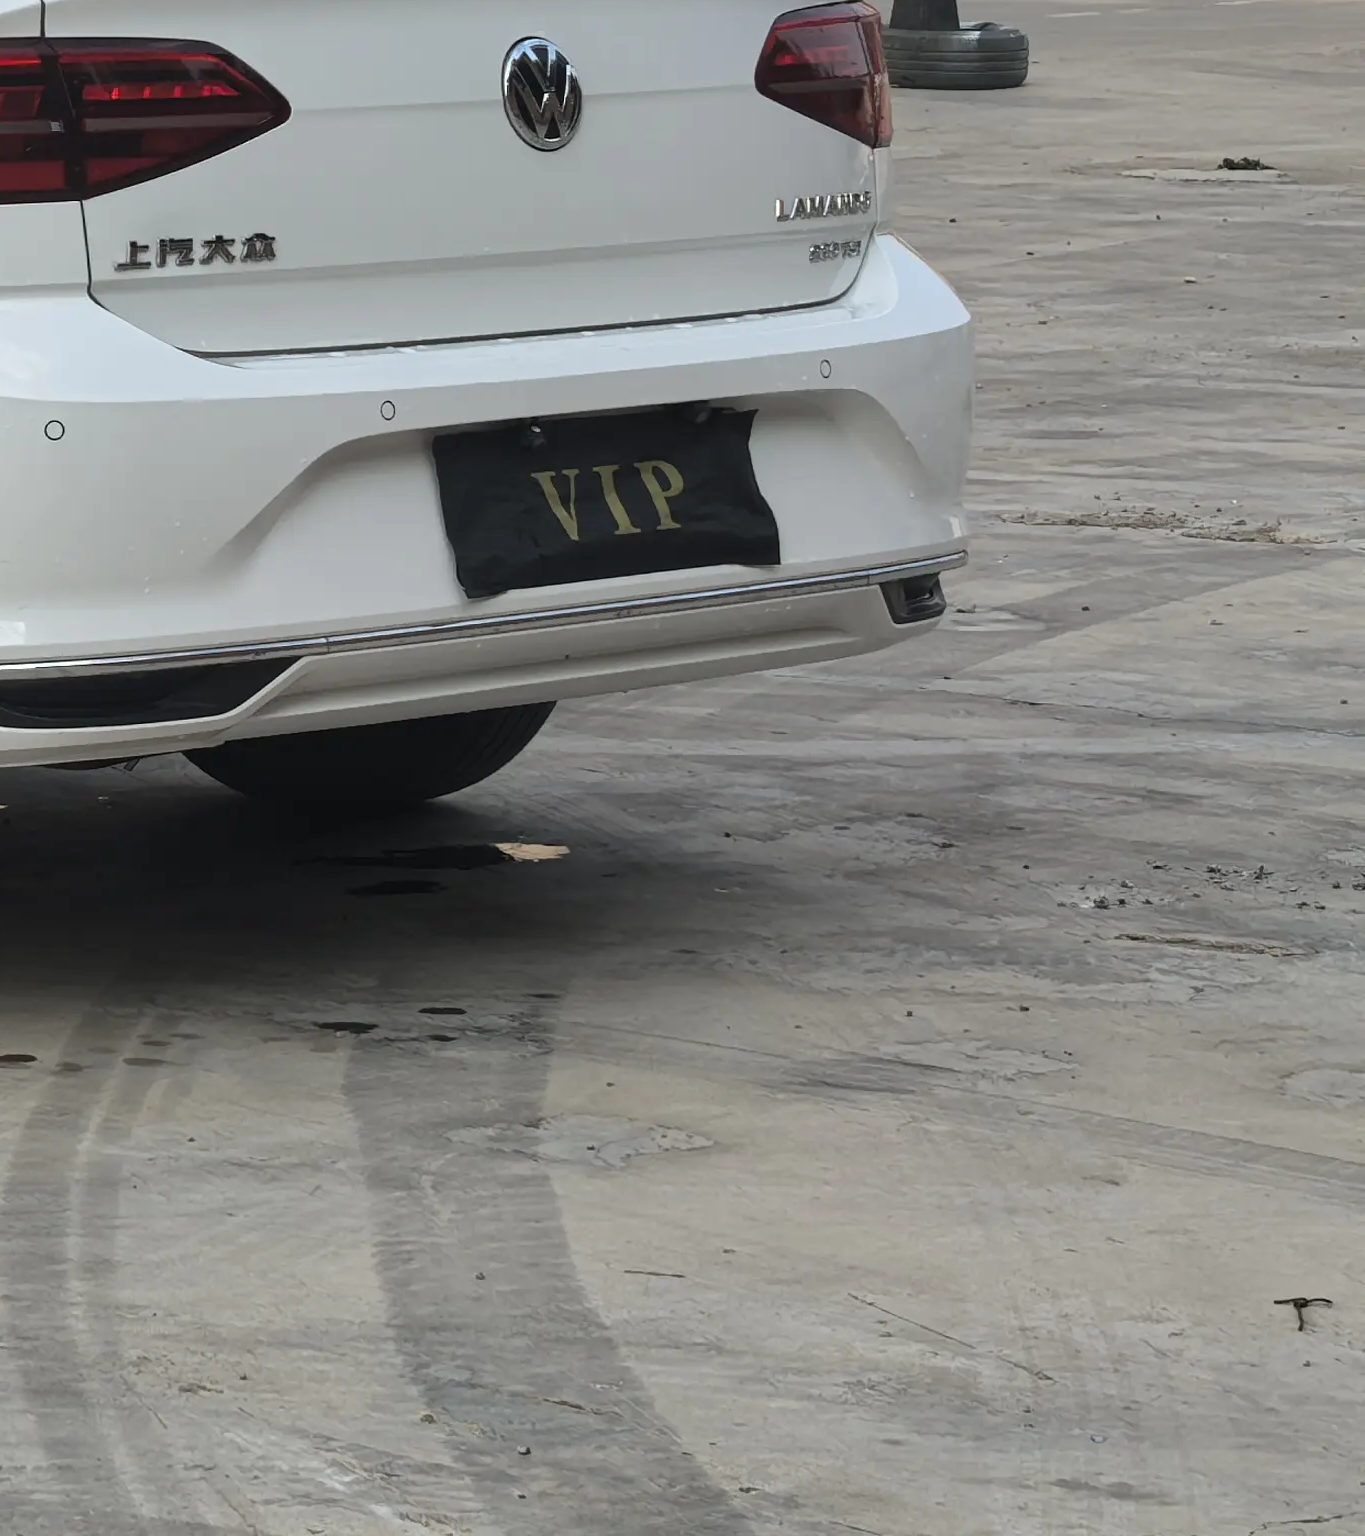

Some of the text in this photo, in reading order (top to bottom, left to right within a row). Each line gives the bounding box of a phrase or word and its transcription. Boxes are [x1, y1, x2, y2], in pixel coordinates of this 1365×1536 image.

[113, 231, 277, 273] 上汽大众
[530, 458, 685, 542] VIP
